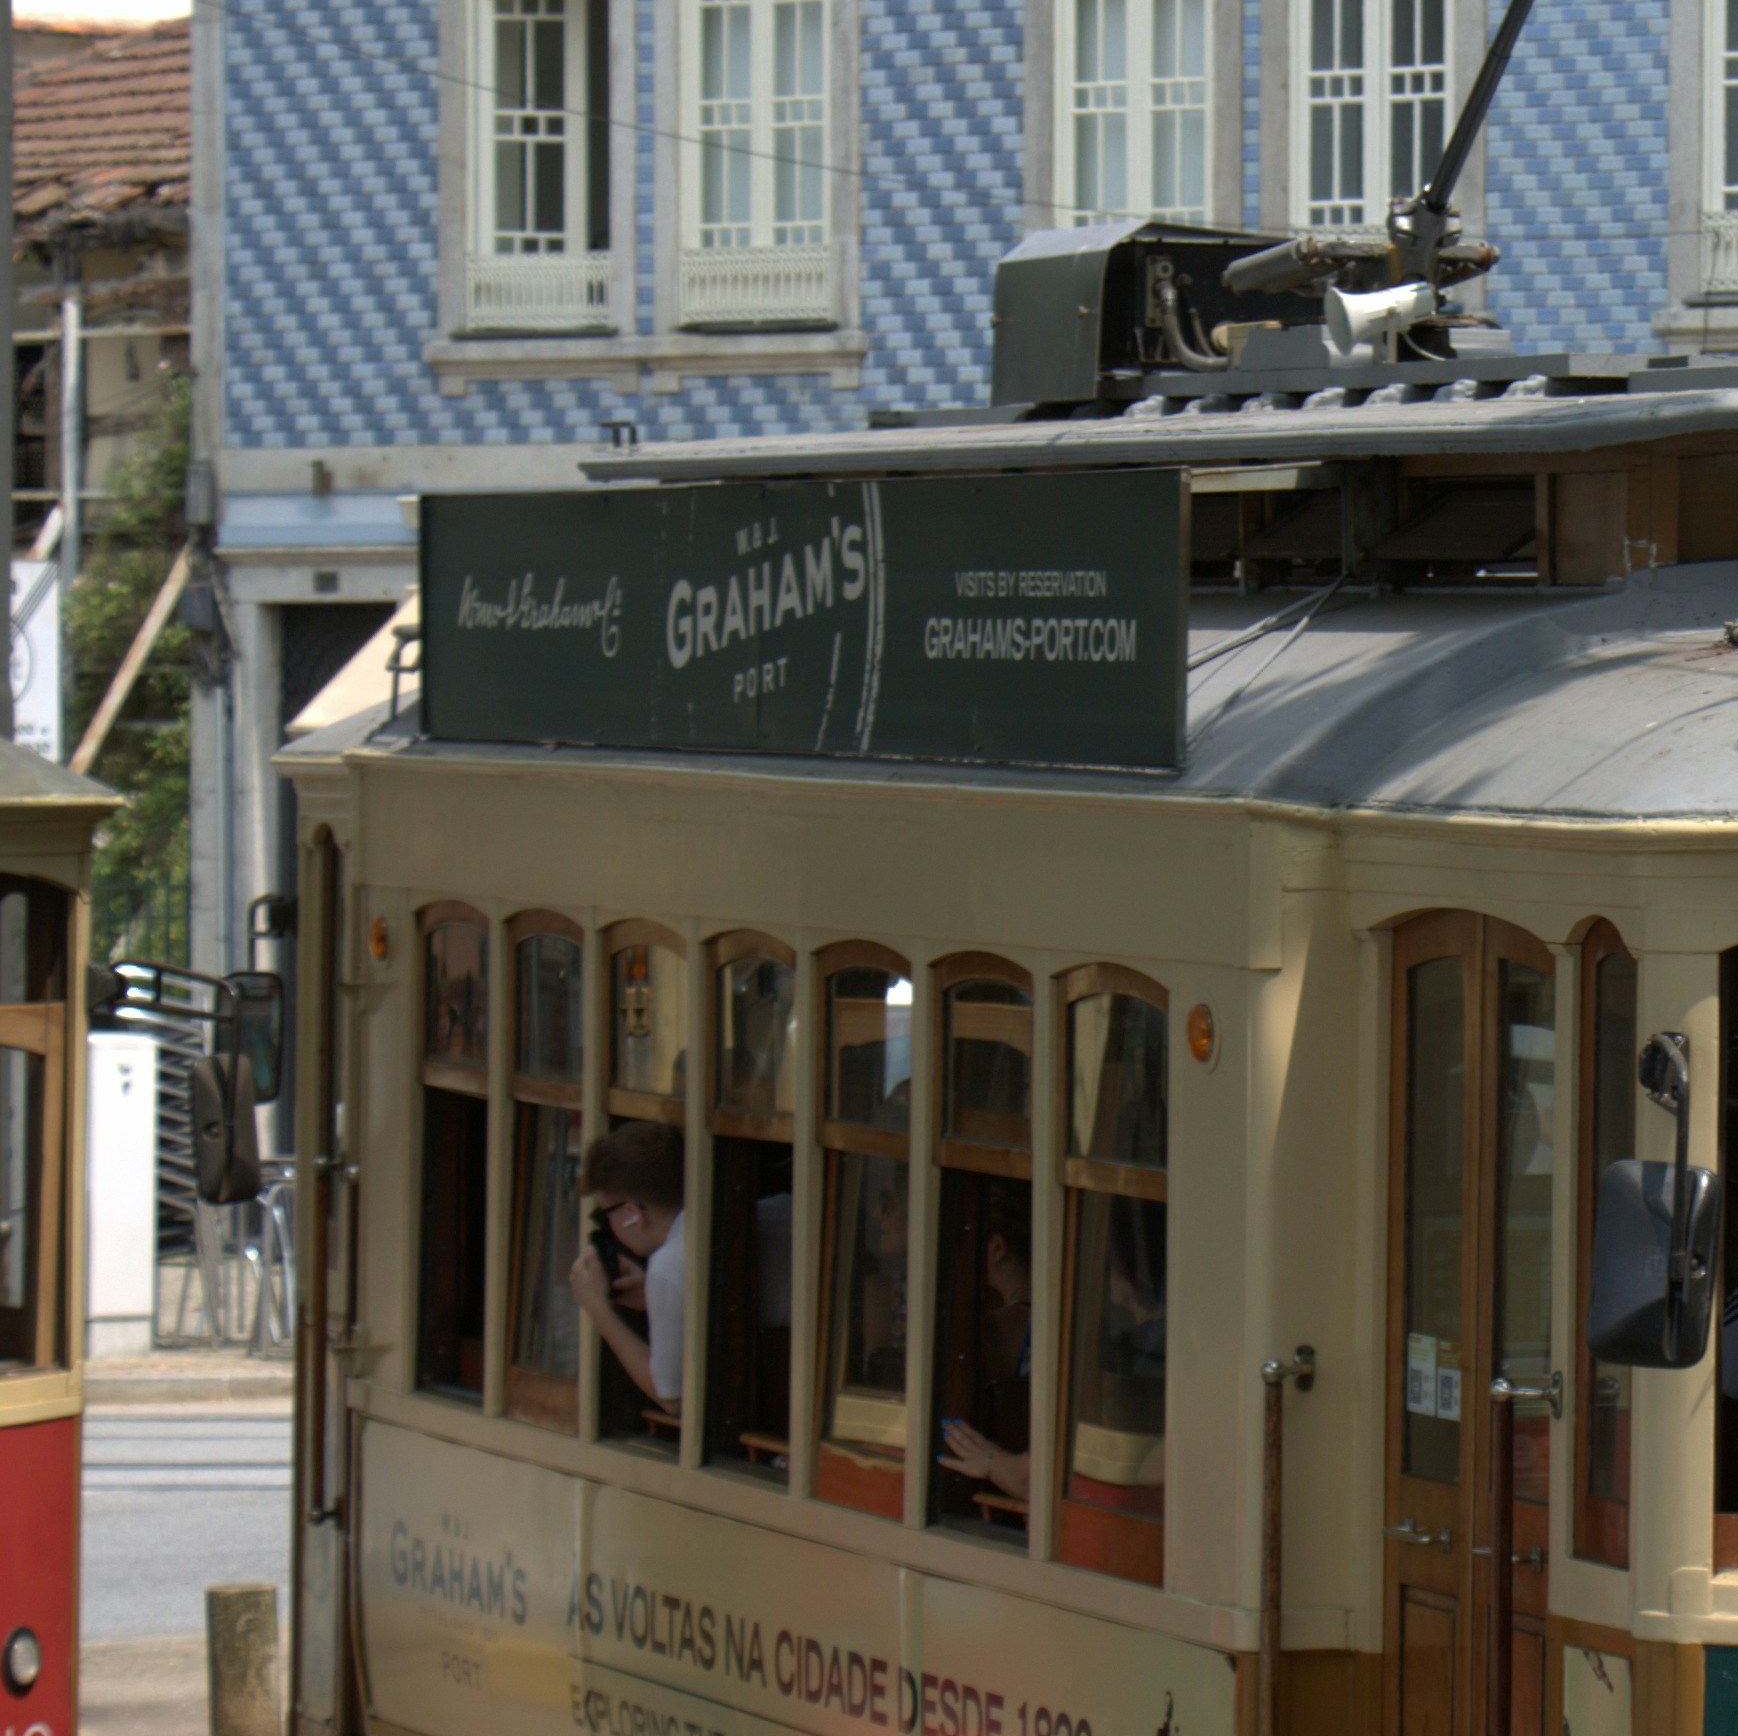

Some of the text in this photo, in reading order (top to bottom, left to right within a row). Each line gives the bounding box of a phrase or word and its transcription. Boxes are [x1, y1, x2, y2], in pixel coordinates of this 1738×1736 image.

[667, 515, 866, 669] GRAHAM'S
[954, 569, 1108, 598] VISITS BY RESERVATION
[924, 616, 1138, 663] GRAHAMS-PORT.COM
[733, 657, 789, 704] PORT
[390, 1518, 528, 1628] GRAHAM'S
[610, 1578, 718, 1671] VOLTAS
[724, 1613, 767, 1689] NA
[774, 1628, 889, 1728] CIDADE
